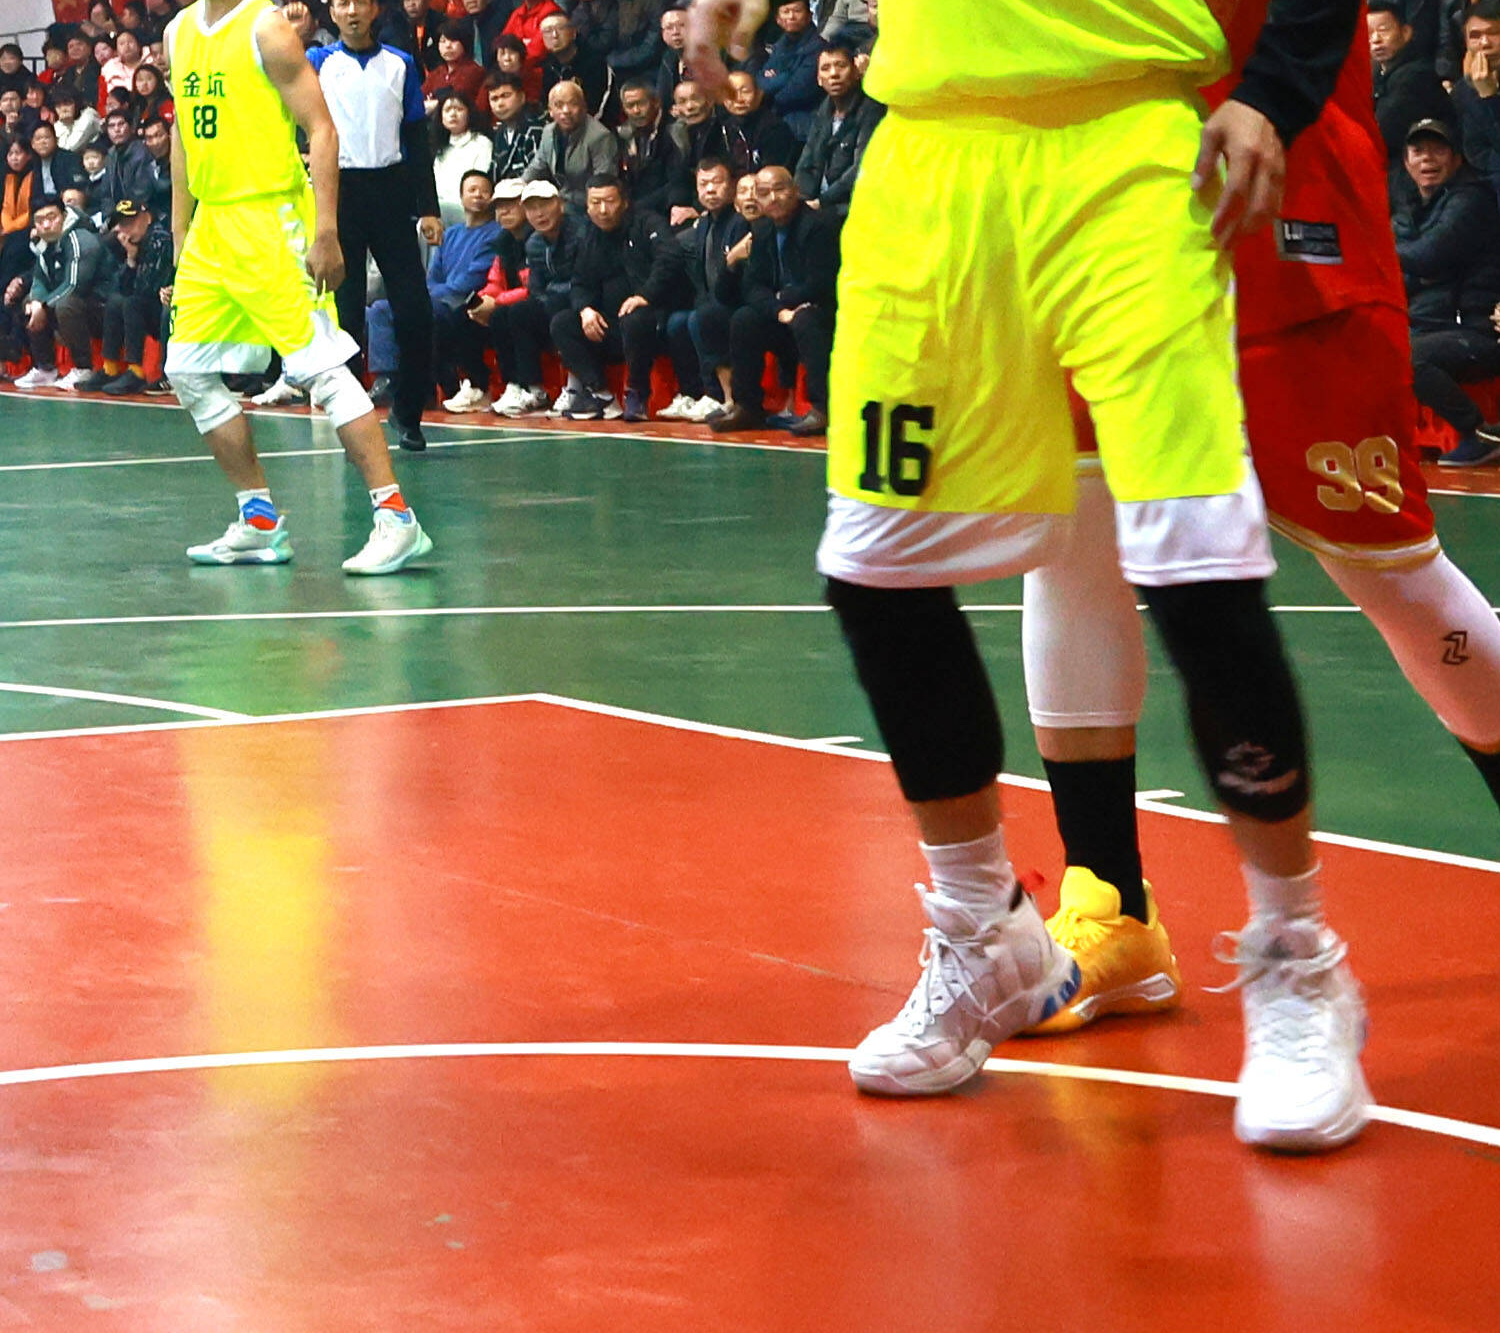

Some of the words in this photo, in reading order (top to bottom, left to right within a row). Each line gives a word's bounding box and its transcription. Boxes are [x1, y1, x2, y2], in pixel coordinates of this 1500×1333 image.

[182, 71, 226, 98] 金坑
[859, 400, 935, 497] 16
[1306, 435, 1401, 513] 99
